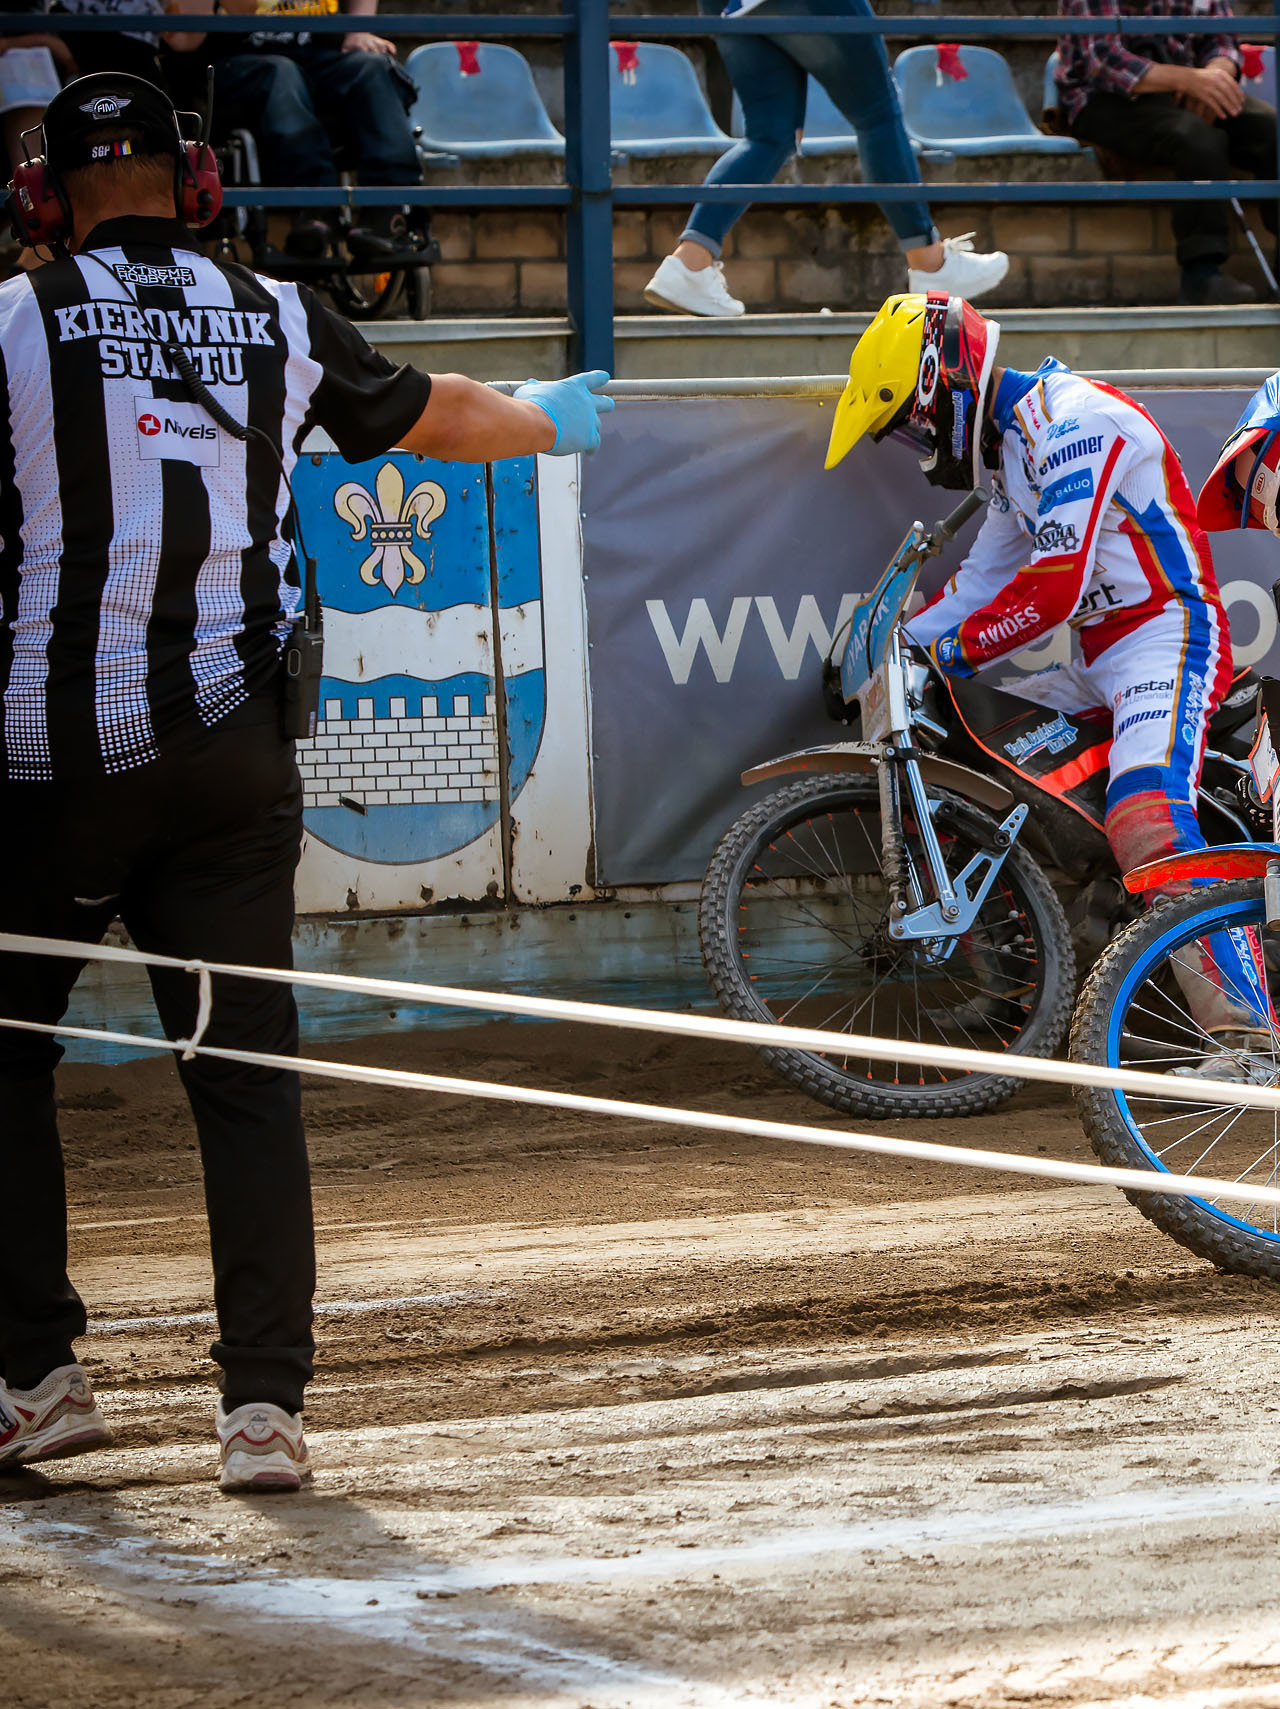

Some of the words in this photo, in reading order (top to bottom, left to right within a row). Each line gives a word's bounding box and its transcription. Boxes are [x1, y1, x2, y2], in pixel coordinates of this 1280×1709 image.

[97, 102, 115, 113] FIM
[91, 145, 110, 158] SGP
[115, 265, 192, 277] EXTREME
[118, 272, 169, 284] HOBBY
[54, 302, 275, 346] KIEROWNIK
[164, 418, 217, 440] Nivels
[978, 605, 1041, 649] AVIDES
